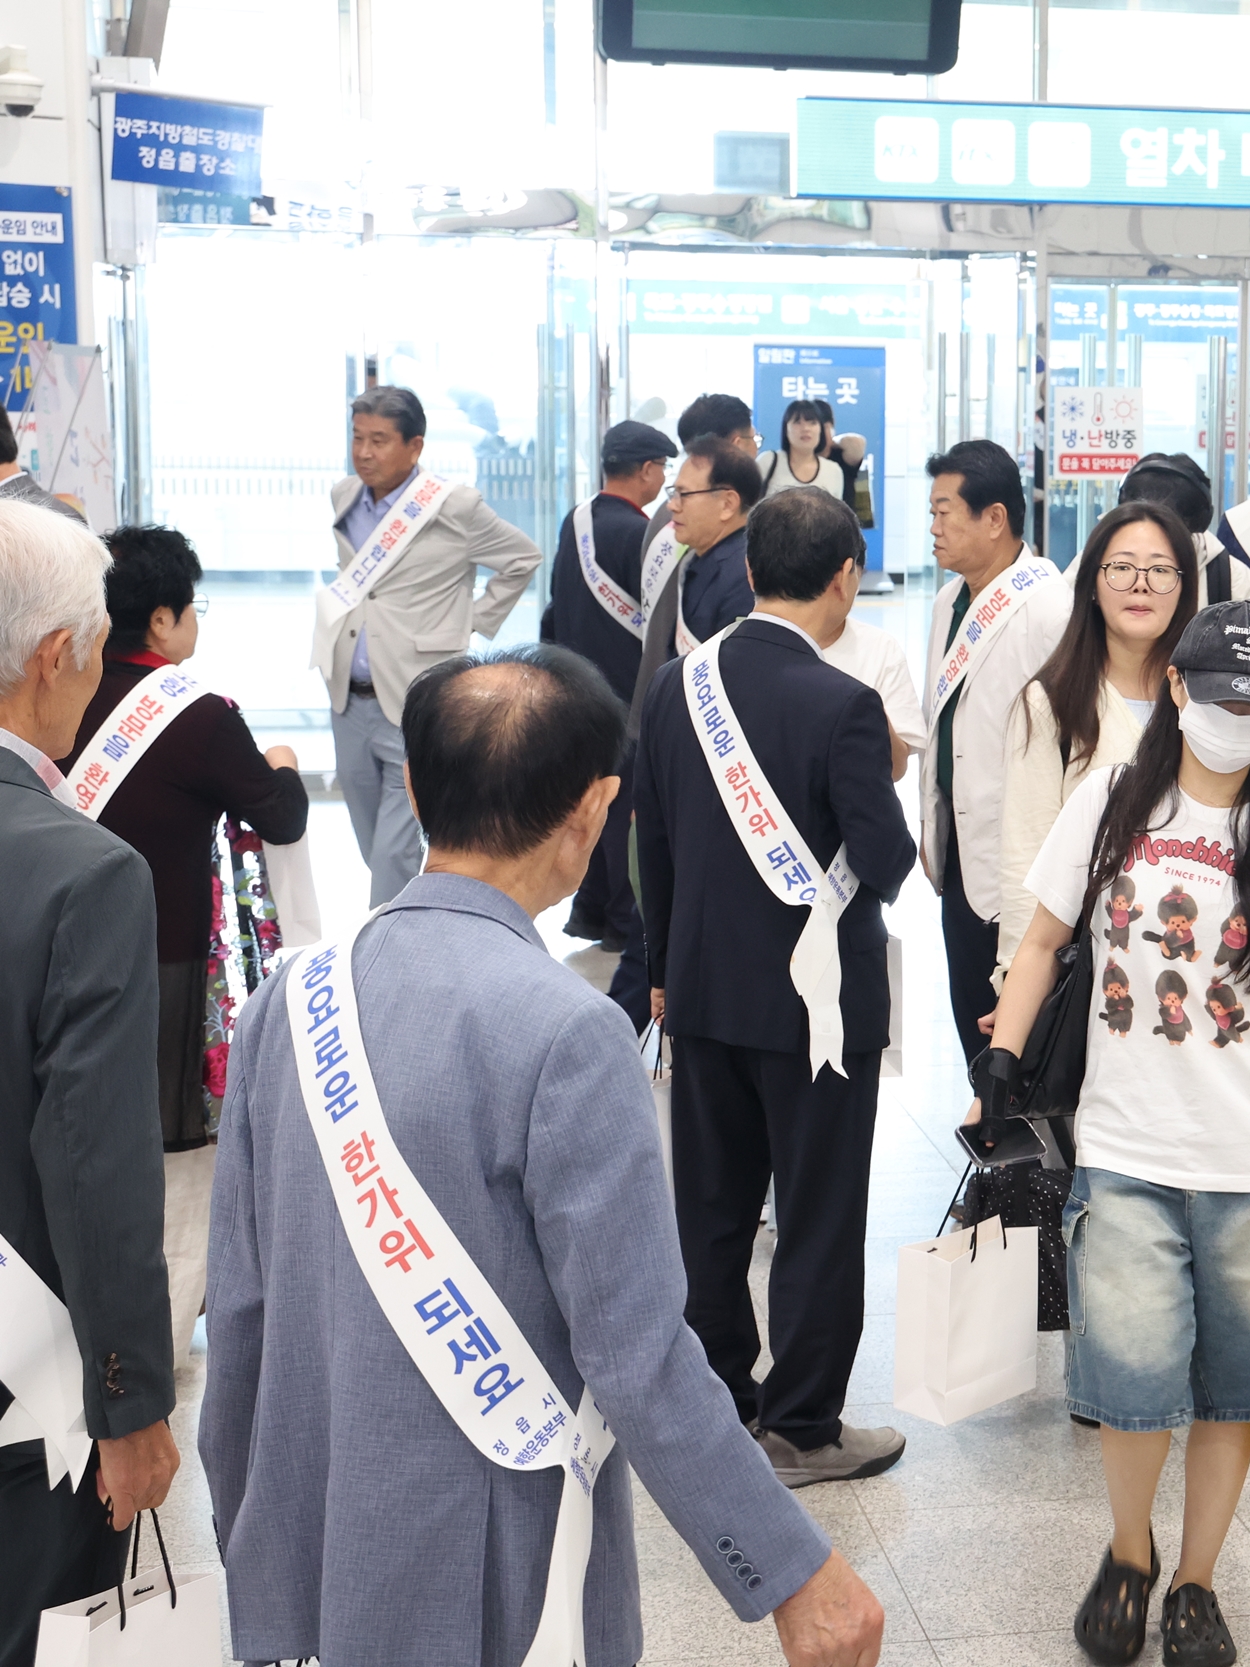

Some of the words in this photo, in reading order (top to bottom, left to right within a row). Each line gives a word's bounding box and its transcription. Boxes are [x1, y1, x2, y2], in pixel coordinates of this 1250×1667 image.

[138, 146, 236, 176] 정읍출장소
[1120, 127, 1226, 189] 열차
[31, 220, 58, 237] 안내
[2, 250, 45, 277] 없이
[39, 284, 61, 309] 시
[835, 377, 860, 404] 곳
[351, 519, 408, 588] 환영합니다
[598, 581, 634, 616] 한가위
[965, 587, 1012, 645] 방문을
[102, 694, 165, 763] 방문을
[691, 659, 736, 759] 풍요로운
[724, 761, 779, 838] 한가위
[1164, 867, 1195, 880] SINCE
[1197, 875, 1221, 886] 1974
[301, 944, 359, 1124] 풍요로운
[341, 1130, 435, 1273] 한가위
[414, 1278, 525, 1416] 되세요
